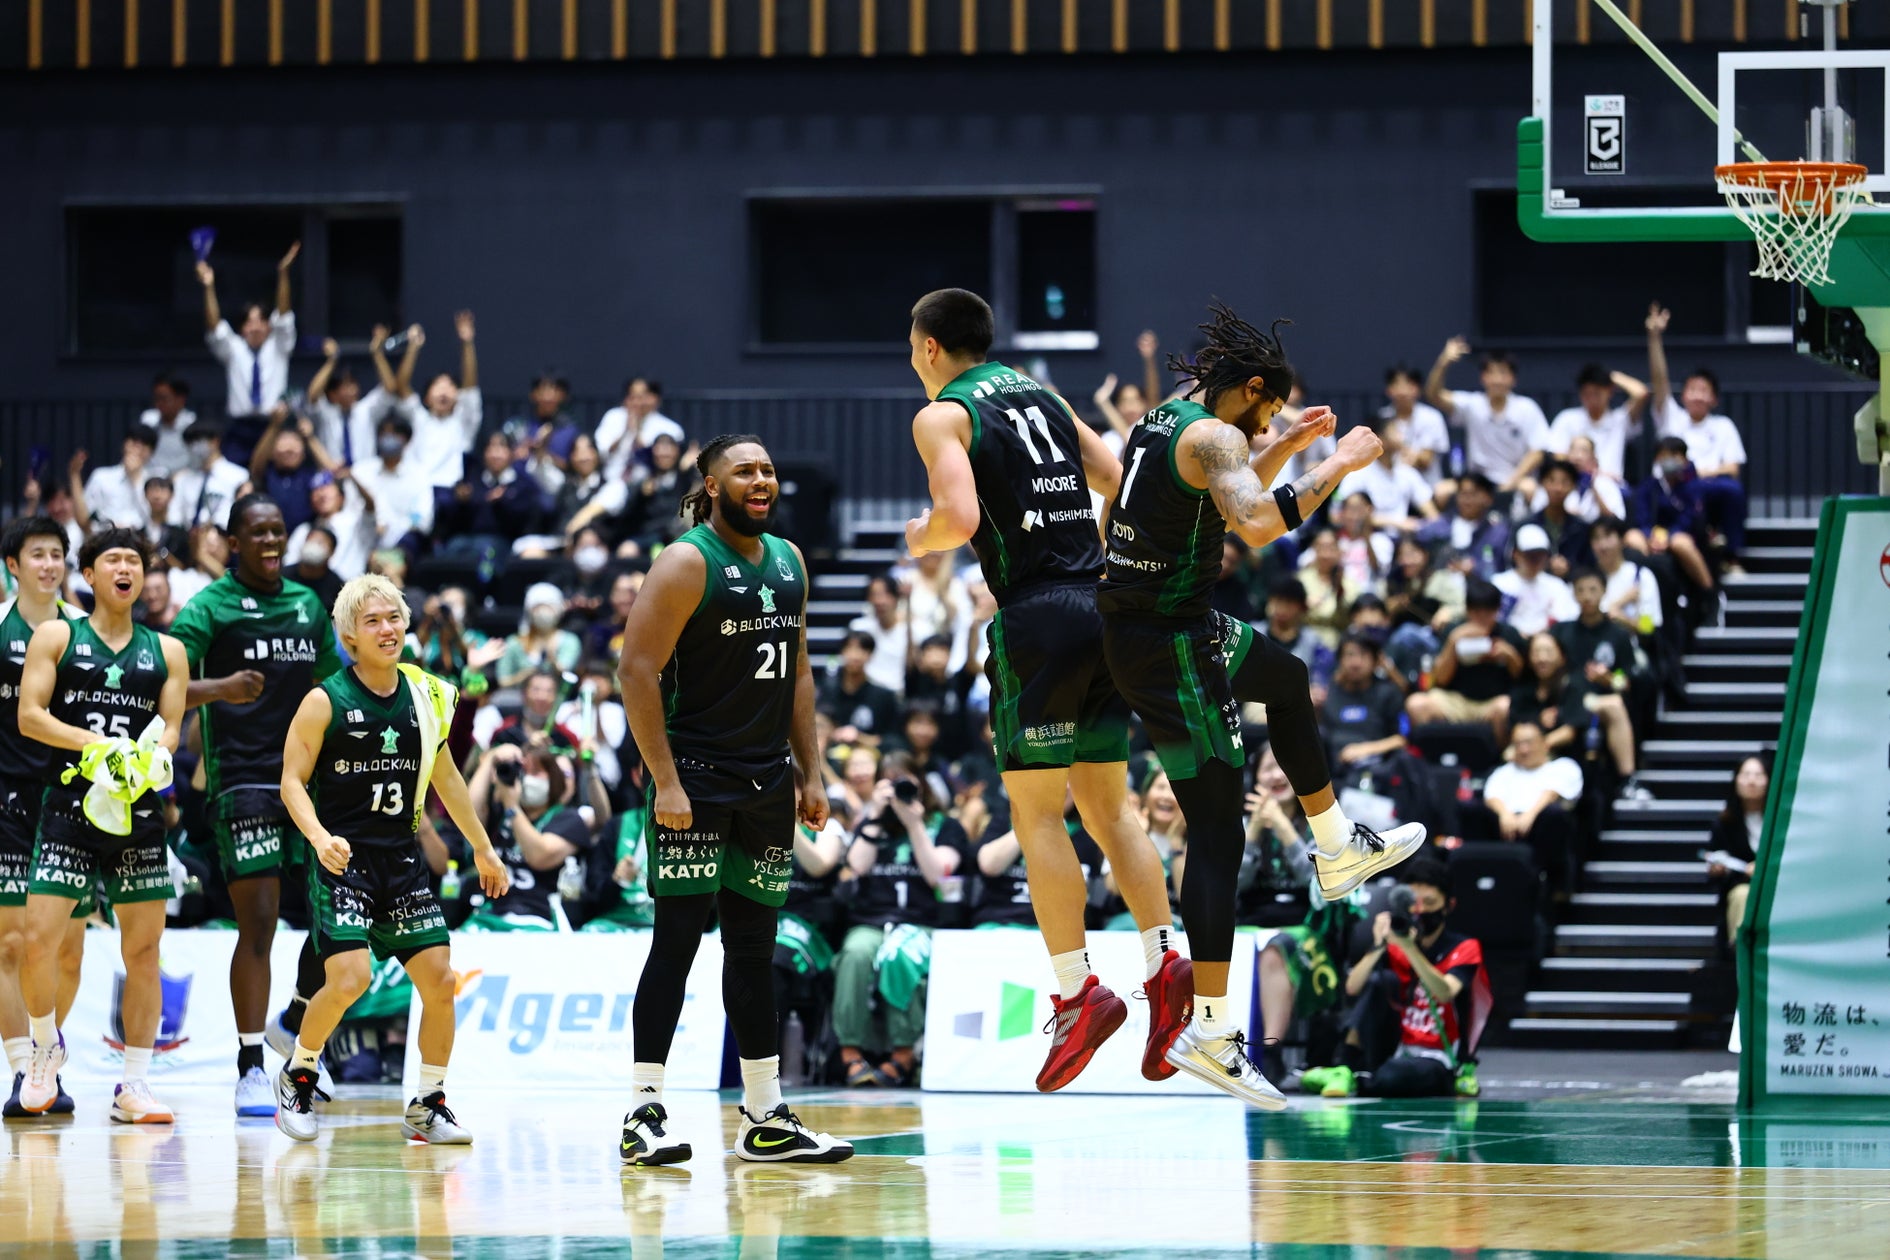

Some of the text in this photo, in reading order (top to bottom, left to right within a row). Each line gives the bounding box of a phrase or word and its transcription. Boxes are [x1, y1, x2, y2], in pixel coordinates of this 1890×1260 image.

[1148, 409, 1180, 428] REAL
[1004, 405, 1066, 465] 11
[1031, 475, 1079, 495] MOORE
[1120, 447, 1147, 510] 1
[1048, 508, 1095, 523] NISHIMAS
[272, 638, 316, 654] REAL
[754, 641, 788, 679] 21
[86, 712, 131, 739] 35
[353, 758, 420, 773] BLOCKVAL
[370, 781, 404, 816] 13
[236, 836, 280, 862] KATO
[35, 867, 87, 888] KATO
[658, 862, 718, 879] KATO
[455, 975, 696, 1055] Age
[1204, 1005, 1213, 1018] 1
[1782, 1001, 1880, 1027] 物流は、
[1783, 1033, 1849, 1057] 愛だ。
[1780, 1064, 1879, 1078] MARUZEN SHOWA
